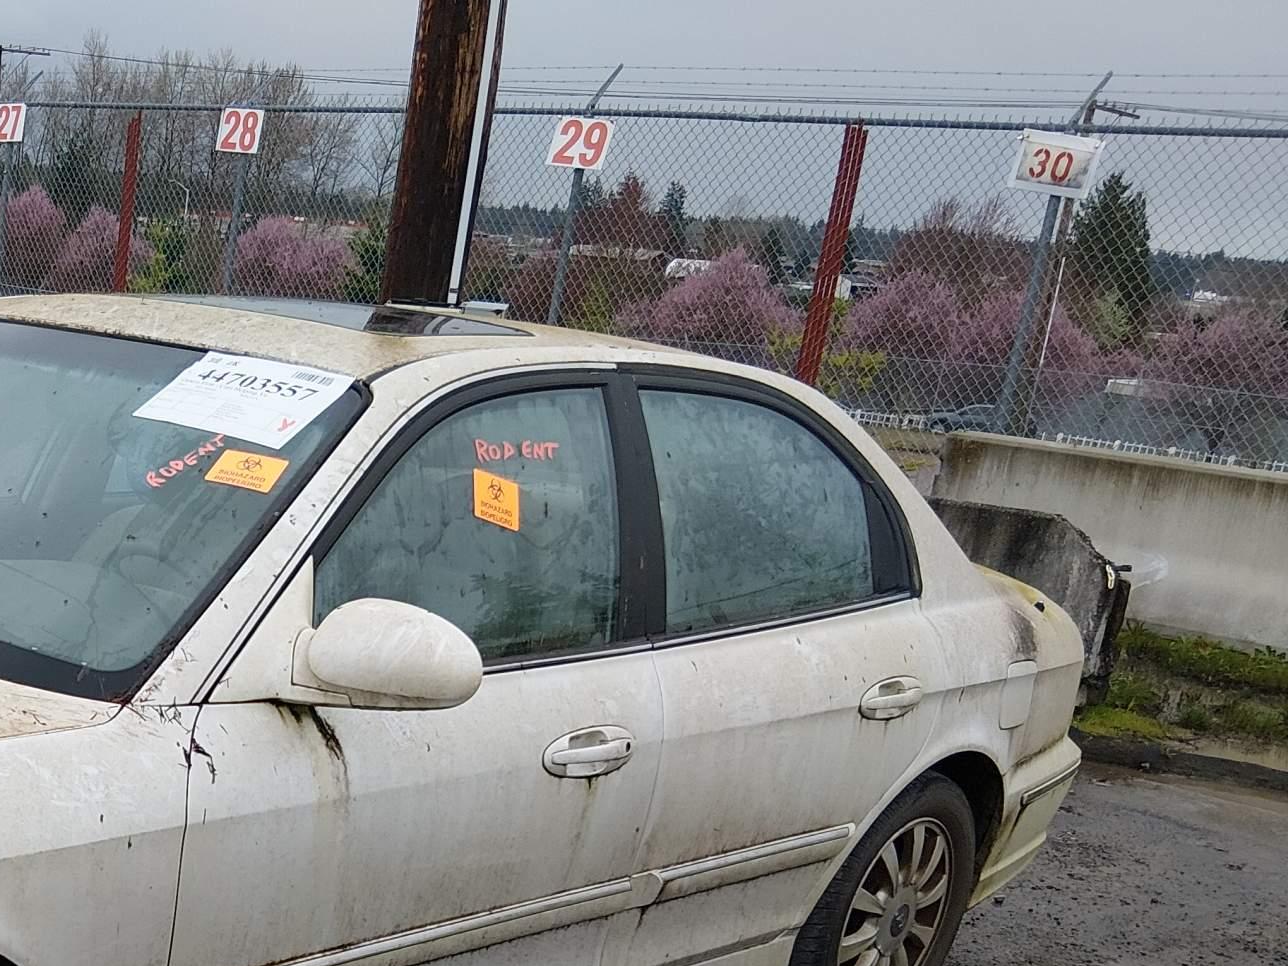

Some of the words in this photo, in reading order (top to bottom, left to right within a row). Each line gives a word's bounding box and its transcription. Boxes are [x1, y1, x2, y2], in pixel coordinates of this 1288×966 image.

[220, 110, 259, 151] 28
[551, 119, 608, 167] 29
[1028, 147, 1074, 183] 30
[198, 369, 319, 401] 44703557
[144, 434, 225, 488] RODENT
